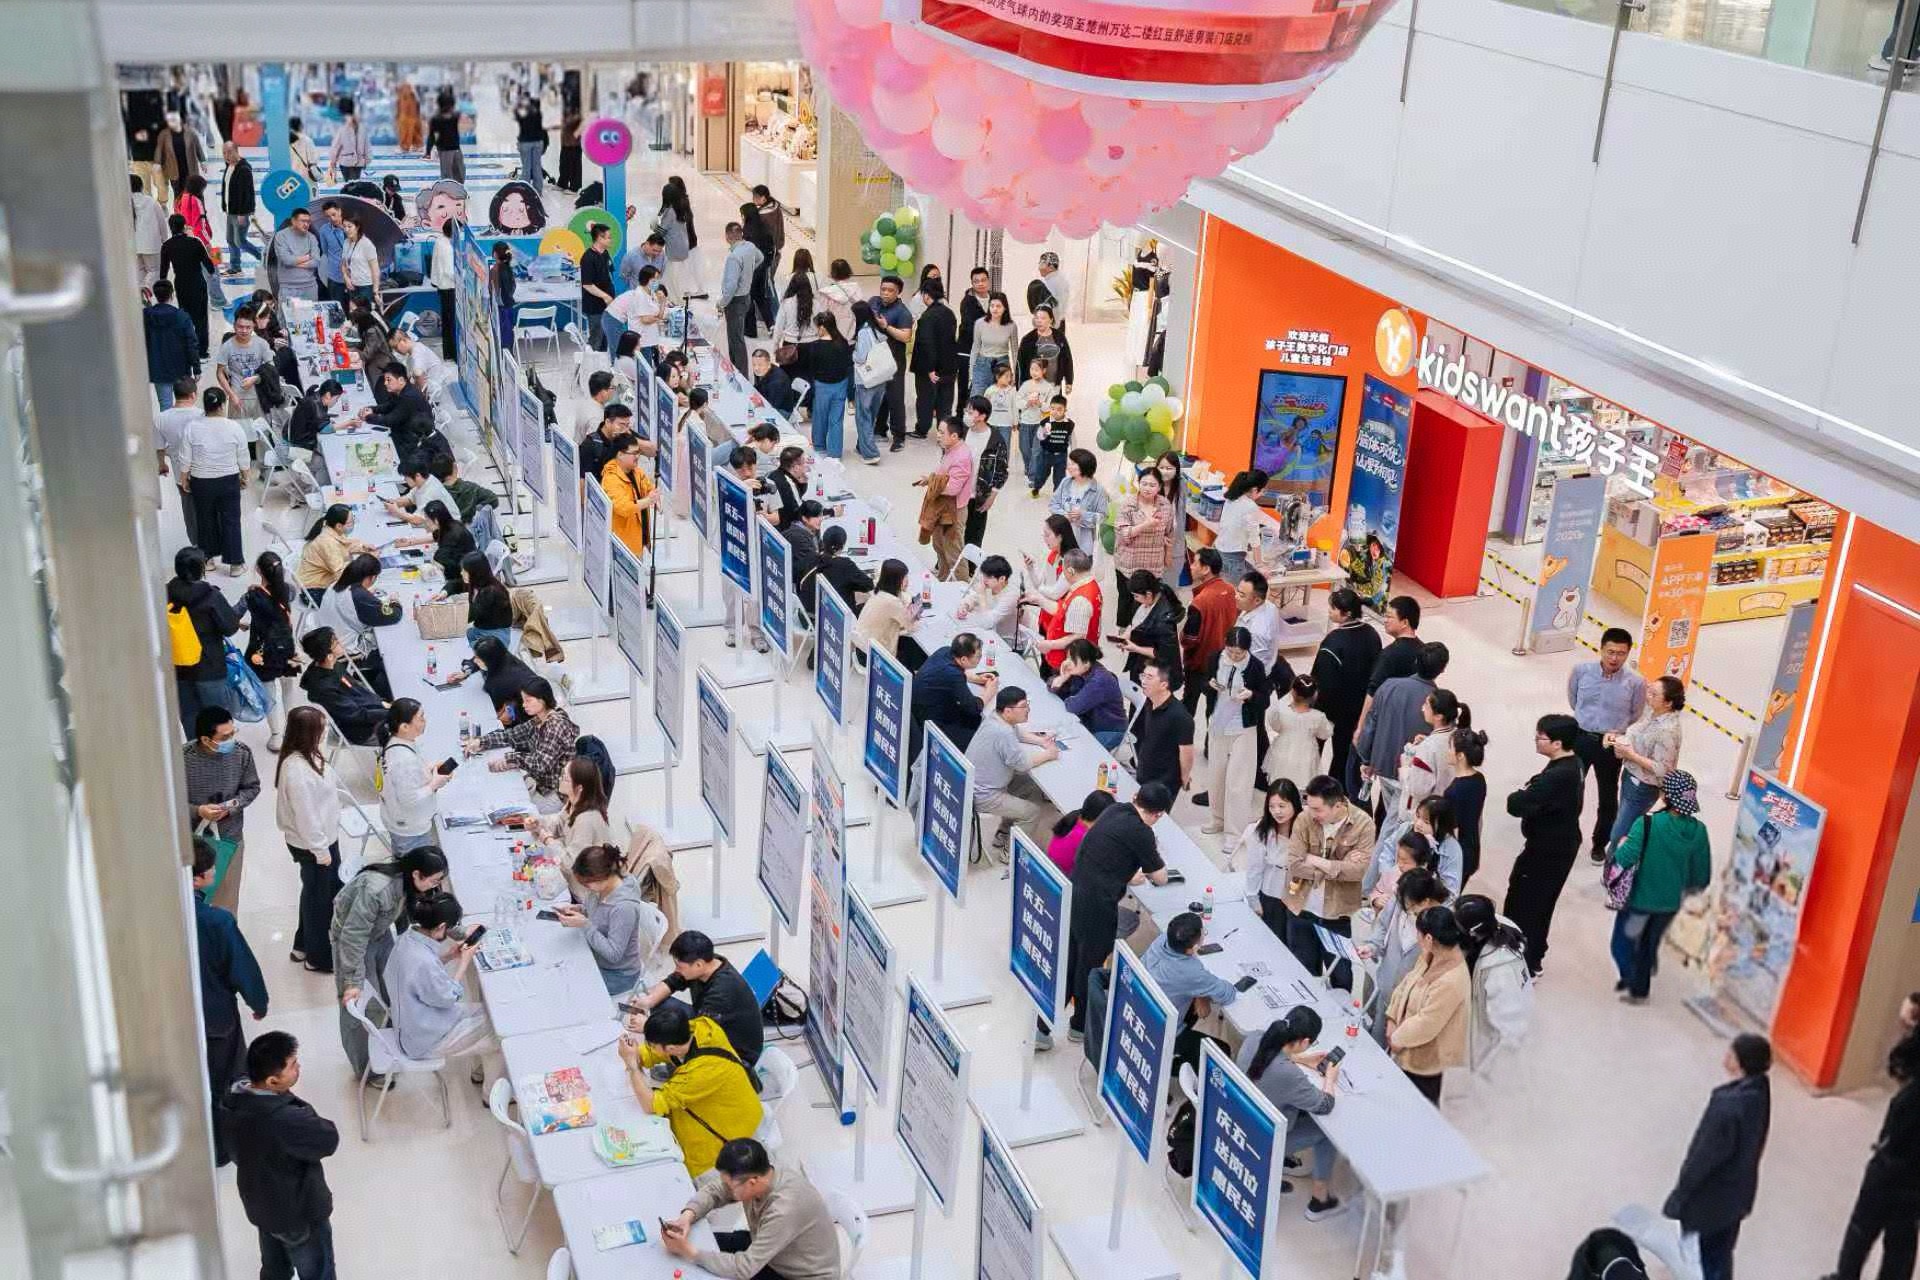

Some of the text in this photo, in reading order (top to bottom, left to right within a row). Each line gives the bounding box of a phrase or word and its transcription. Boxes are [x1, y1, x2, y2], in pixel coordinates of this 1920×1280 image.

[1022, 880, 1055, 922] 庆五一
[1121, 1001, 1156, 1050] 庆五一
[1215, 1106, 1261, 1161] 庆五一
